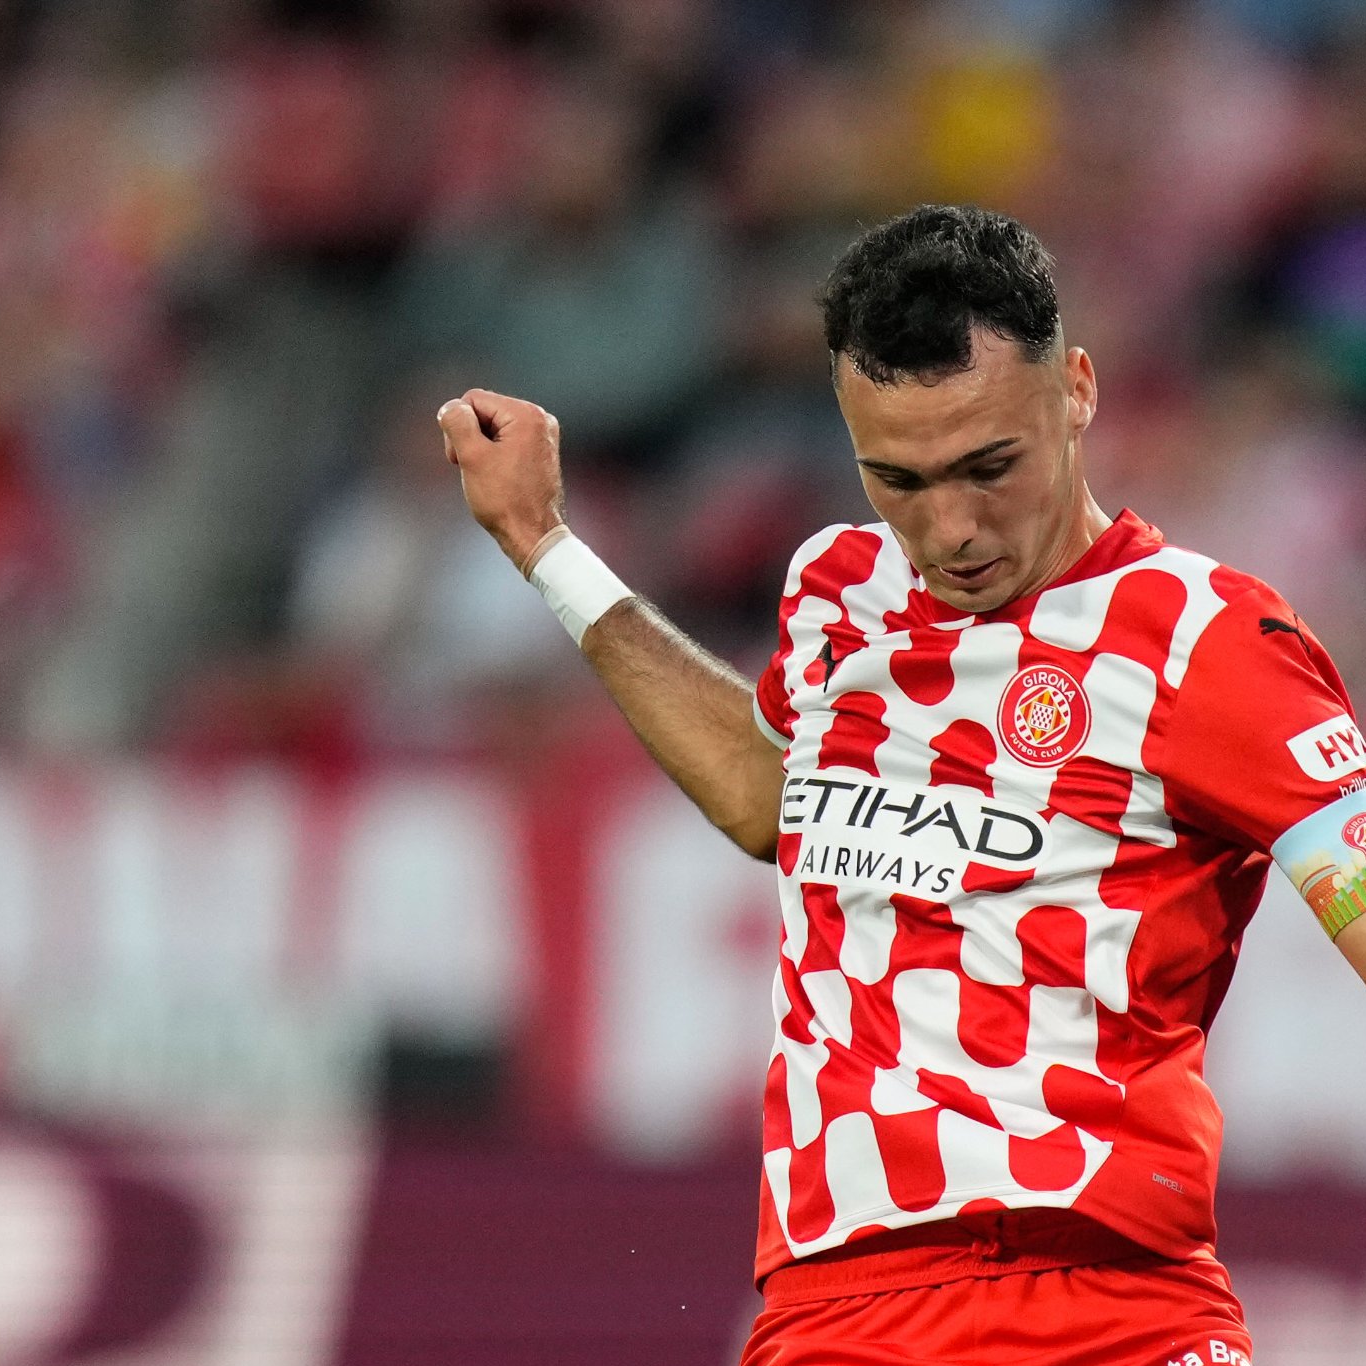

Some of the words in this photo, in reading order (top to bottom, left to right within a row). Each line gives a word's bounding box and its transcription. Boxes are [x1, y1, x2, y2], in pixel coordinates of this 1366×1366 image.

[1023, 671, 1076, 702] GIRONA
[1010, 732, 1038, 757] FUTBOL
[1040, 745, 1063, 758] CLUB
[783, 777, 1044, 862] ETIHAD
[800, 845, 955, 893] AIRWAYS
